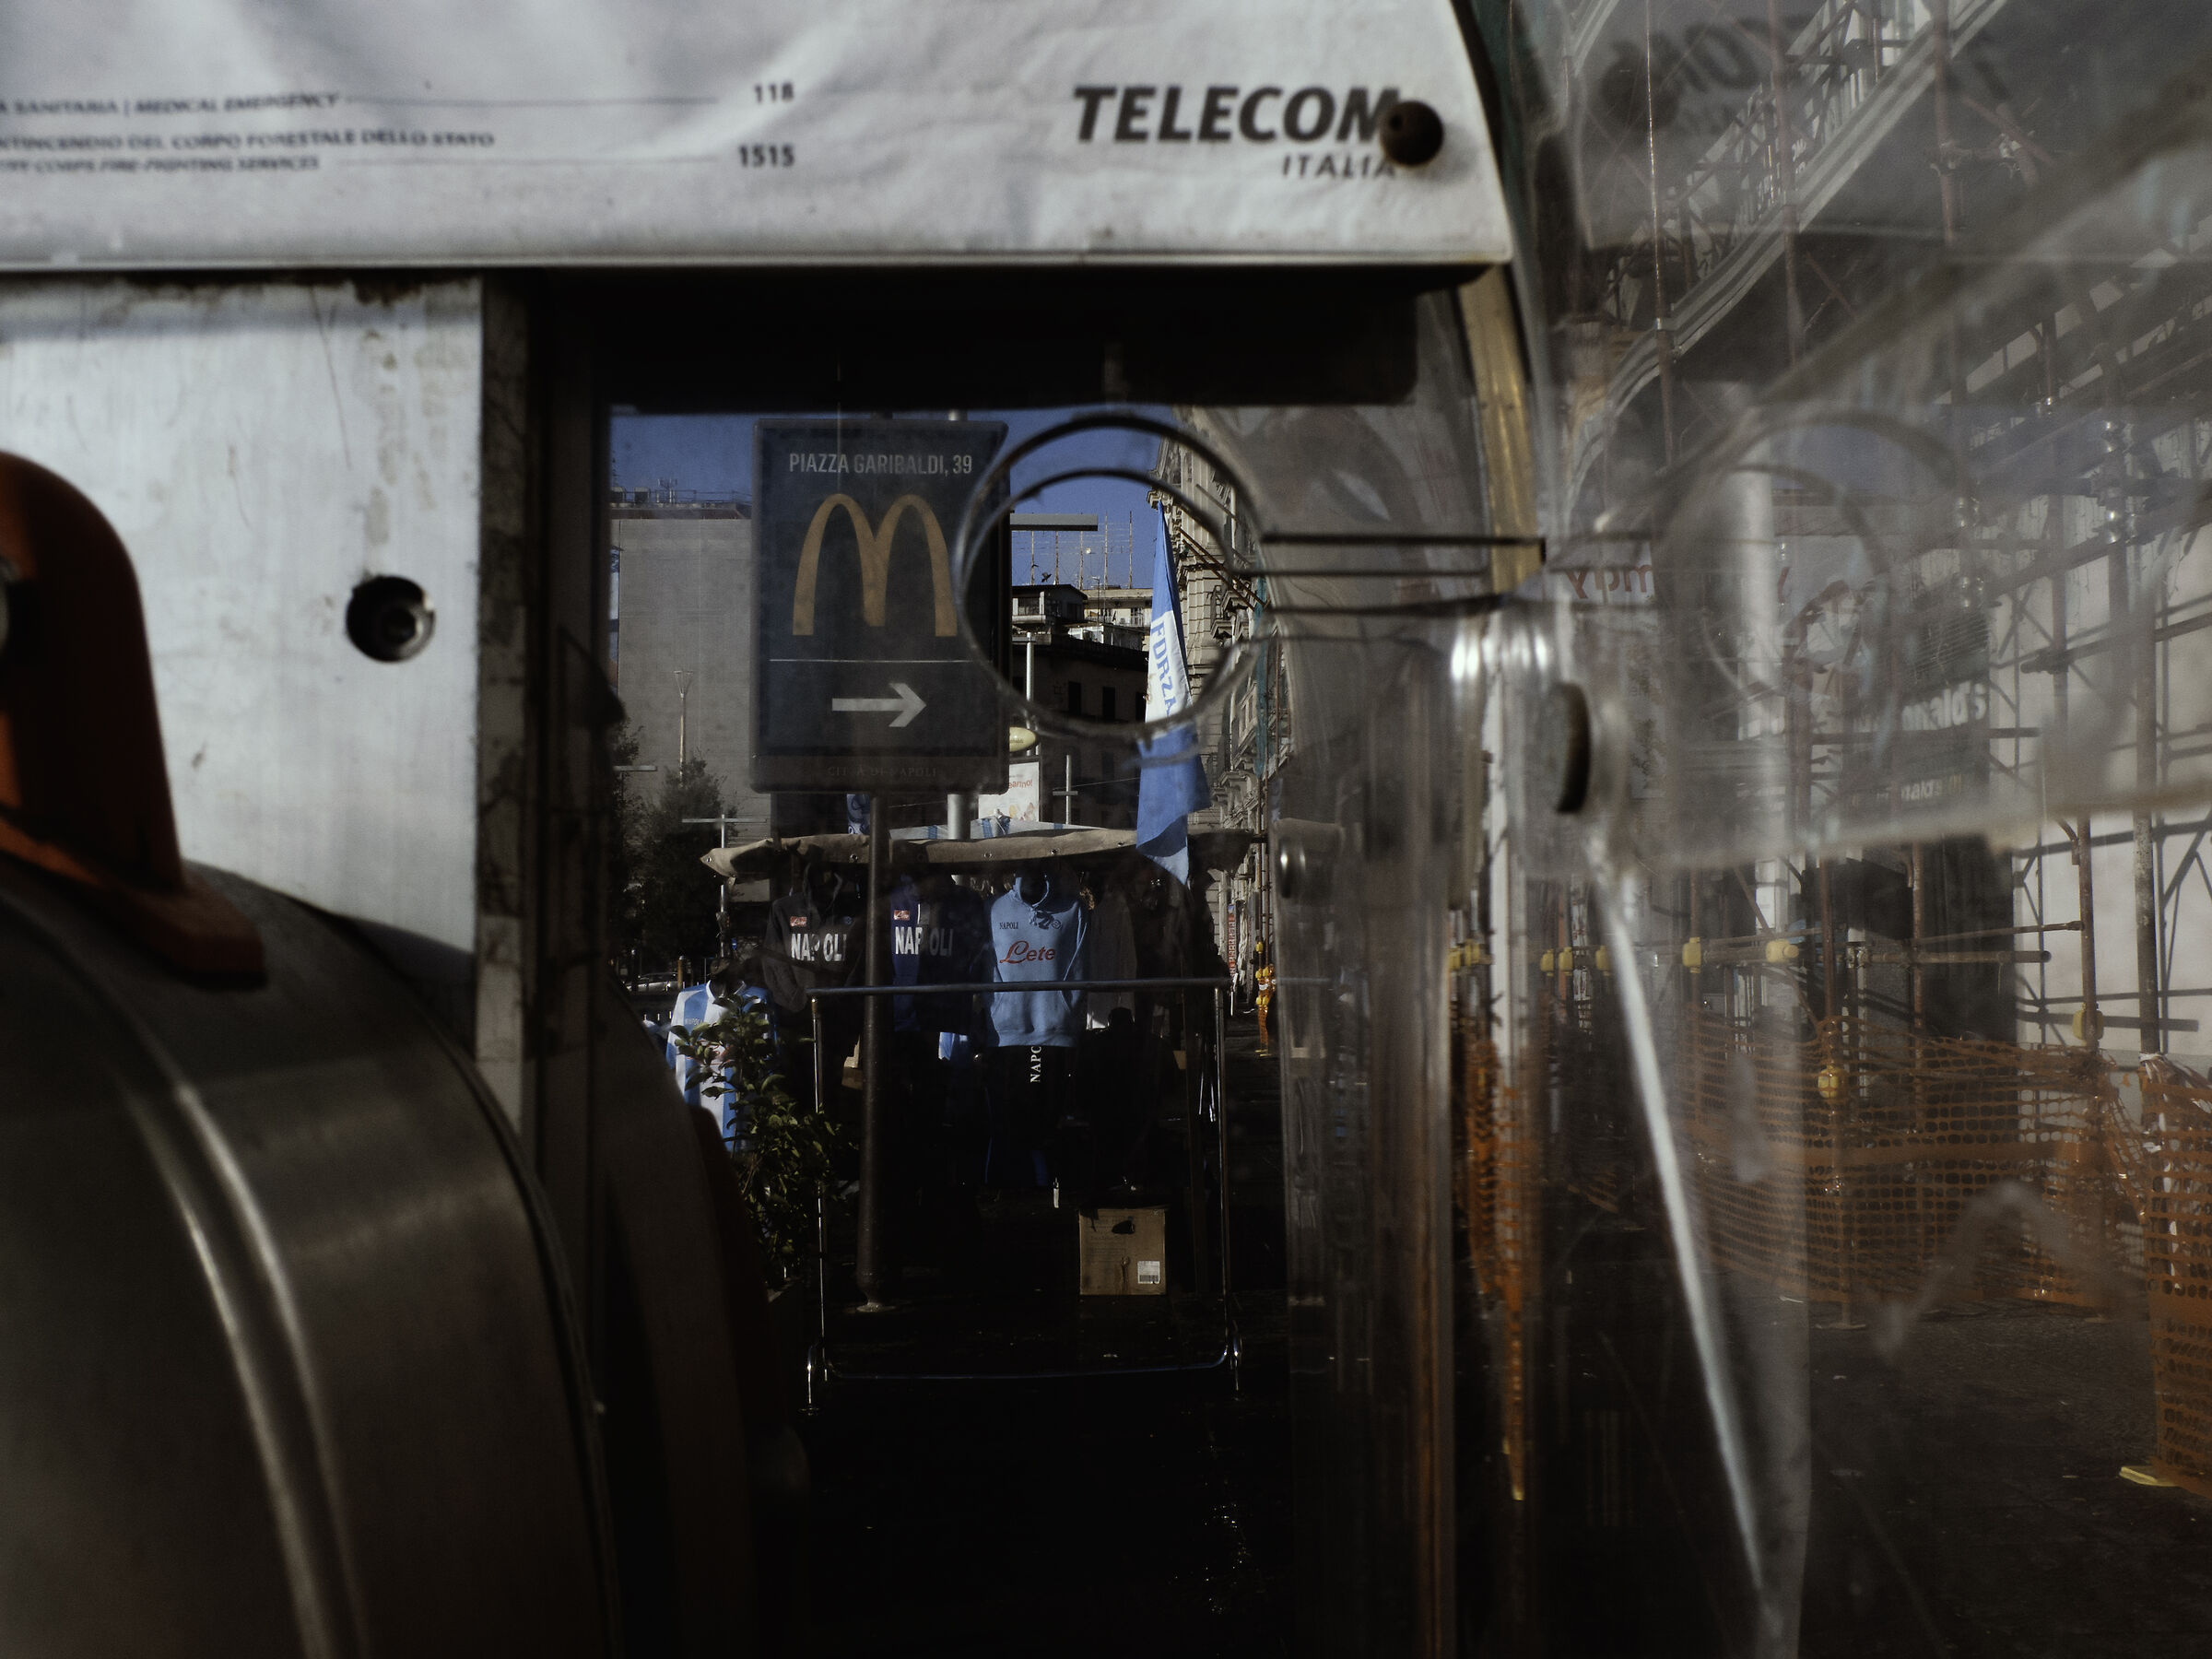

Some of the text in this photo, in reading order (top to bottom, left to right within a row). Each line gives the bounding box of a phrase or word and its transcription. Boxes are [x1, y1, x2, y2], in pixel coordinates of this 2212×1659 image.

[754, 81, 795, 103] 118
[1073, 85, 1403, 144] TELECOM
[127, 134, 163, 149] DEL
[361, 127, 427, 147] DELLO
[432, 132, 496, 147] STATO
[738, 145, 795, 168] 1515
[1282, 152, 1398, 180] ITALIA
[789, 453, 973, 477] PIAZZA GARIBALDI, 39
[1151, 620, 1177, 717] FORZA
[889, 766, 937, 777] APOLI
[999, 922, 1019, 930] NAPOLI
[894, 925, 954, 957] NAPOLI
[999, 939, 1056, 964] Lete
